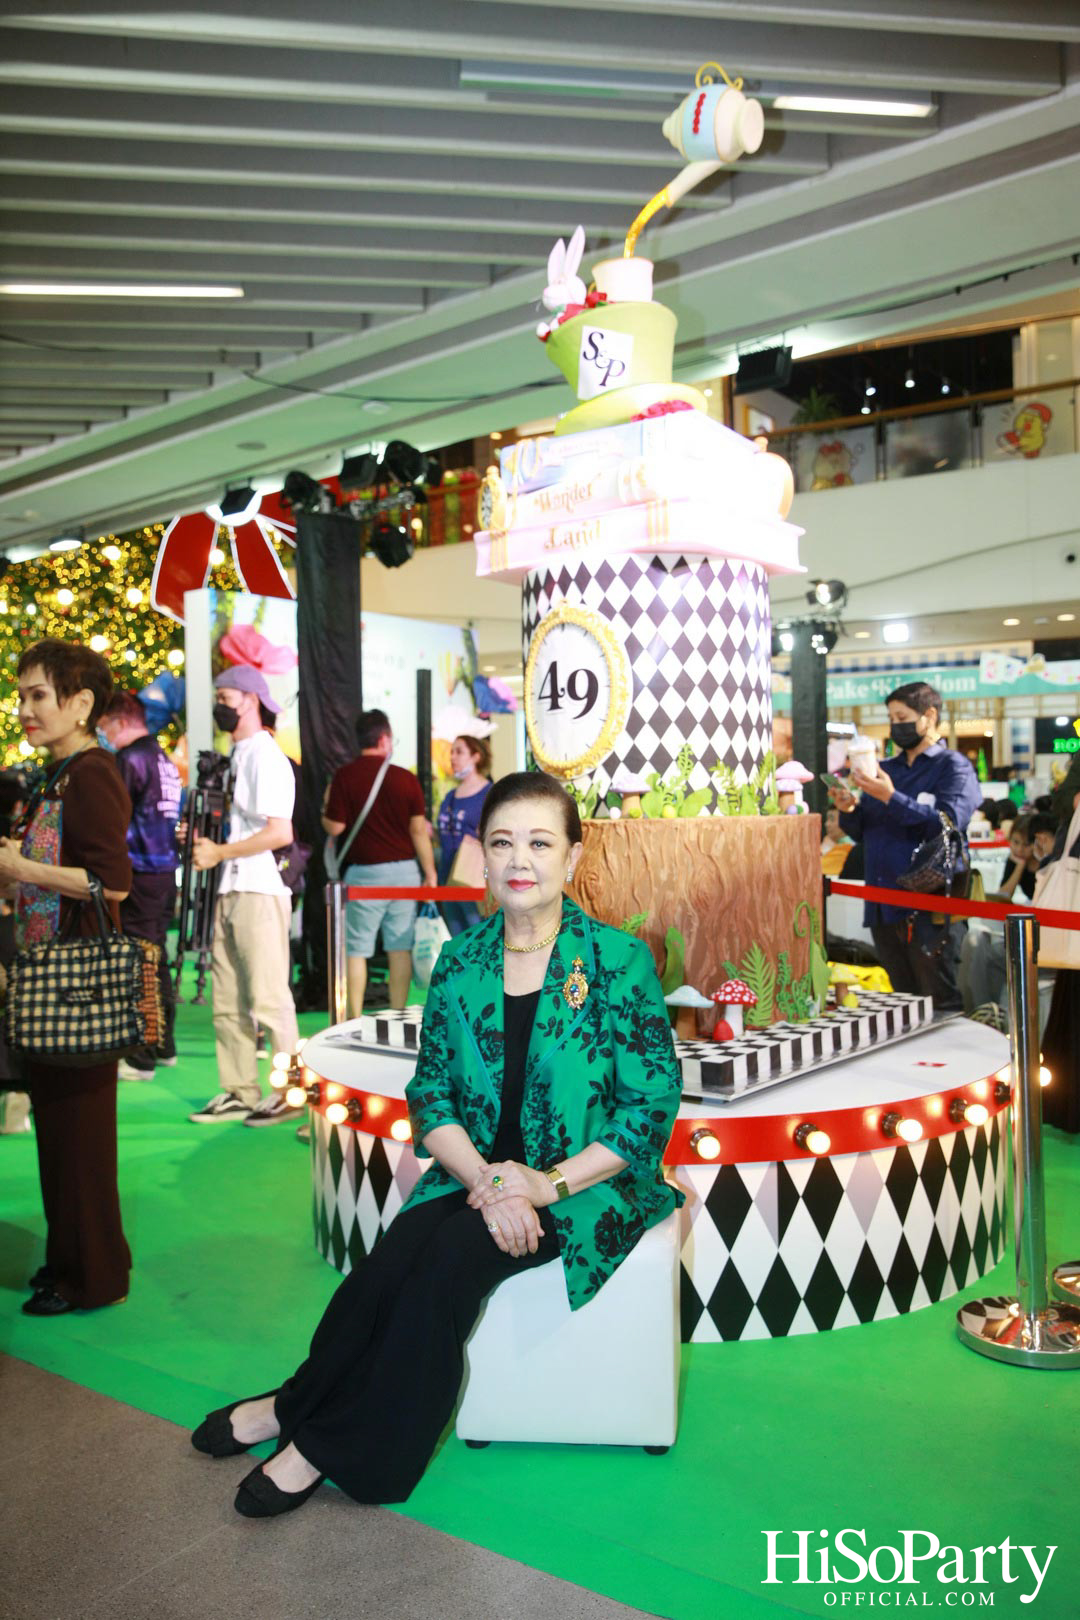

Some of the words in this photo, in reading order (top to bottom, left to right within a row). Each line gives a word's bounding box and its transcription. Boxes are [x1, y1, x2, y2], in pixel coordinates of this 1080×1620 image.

[534, 481, 595, 513] Wonder
[544, 520, 601, 550] Land
[538, 660, 599, 720] 49
